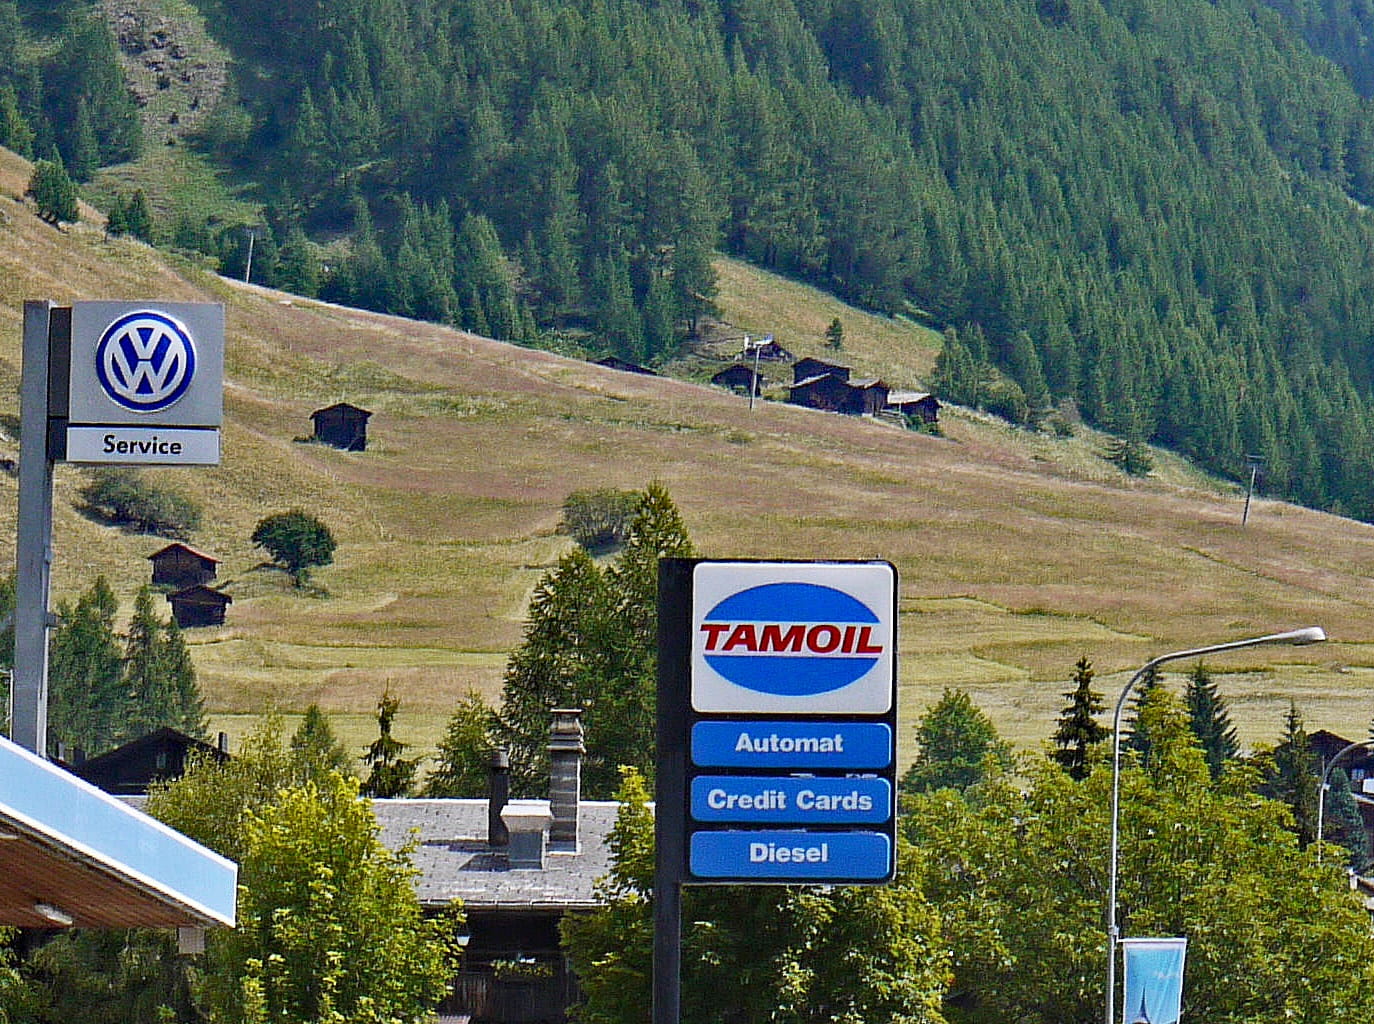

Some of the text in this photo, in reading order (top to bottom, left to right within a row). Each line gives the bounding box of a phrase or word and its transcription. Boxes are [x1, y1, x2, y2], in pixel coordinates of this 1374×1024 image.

[103, 434, 182, 455] Service
[699, 624, 883, 655] TAMOIL
[735, 733, 844, 753] Automat
[707, 788, 873, 811] Credit Cards
[749, 842, 828, 864] Diesel
